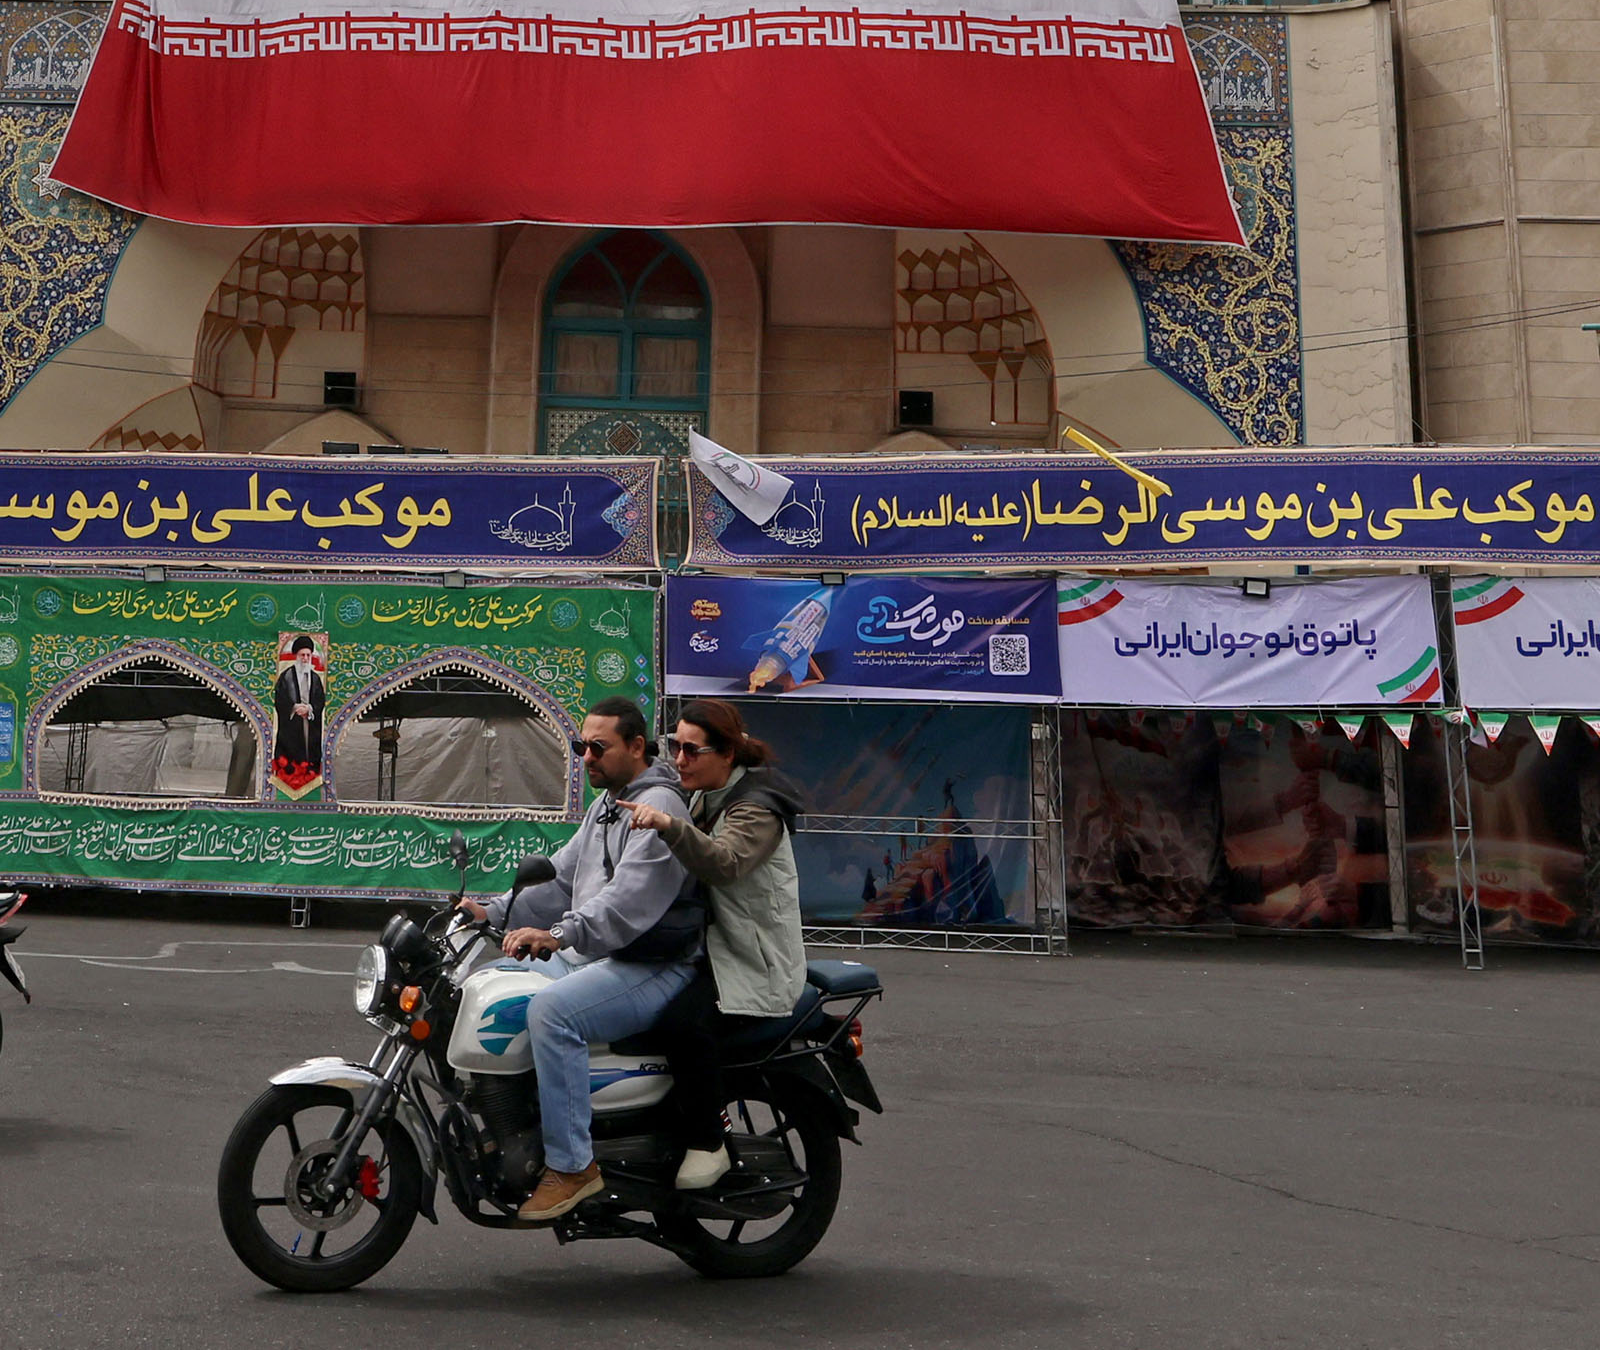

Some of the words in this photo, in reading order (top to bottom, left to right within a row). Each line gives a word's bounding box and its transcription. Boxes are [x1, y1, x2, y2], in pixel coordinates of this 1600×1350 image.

[123, 479, 188, 543] بن
[192, 472, 297, 543] علی
[302, 482, 451, 549] موکب
[1162, 489, 1302, 544] موسی
[1307, 482, 1363, 541] بن
[1367, 473, 1458, 541] علی
[1463, 478, 1594, 544] موکب
[968, 616, 994, 626] ساخت
[995, 616, 1030, 626] مسابقه
[1114, 621, 1187, 658] ایرانی
[1188, 622, 1294, 658] نوجوان
[1295, 619, 1377, 660] پاتوق
[1516, 620, 1595, 657] ایرانی
